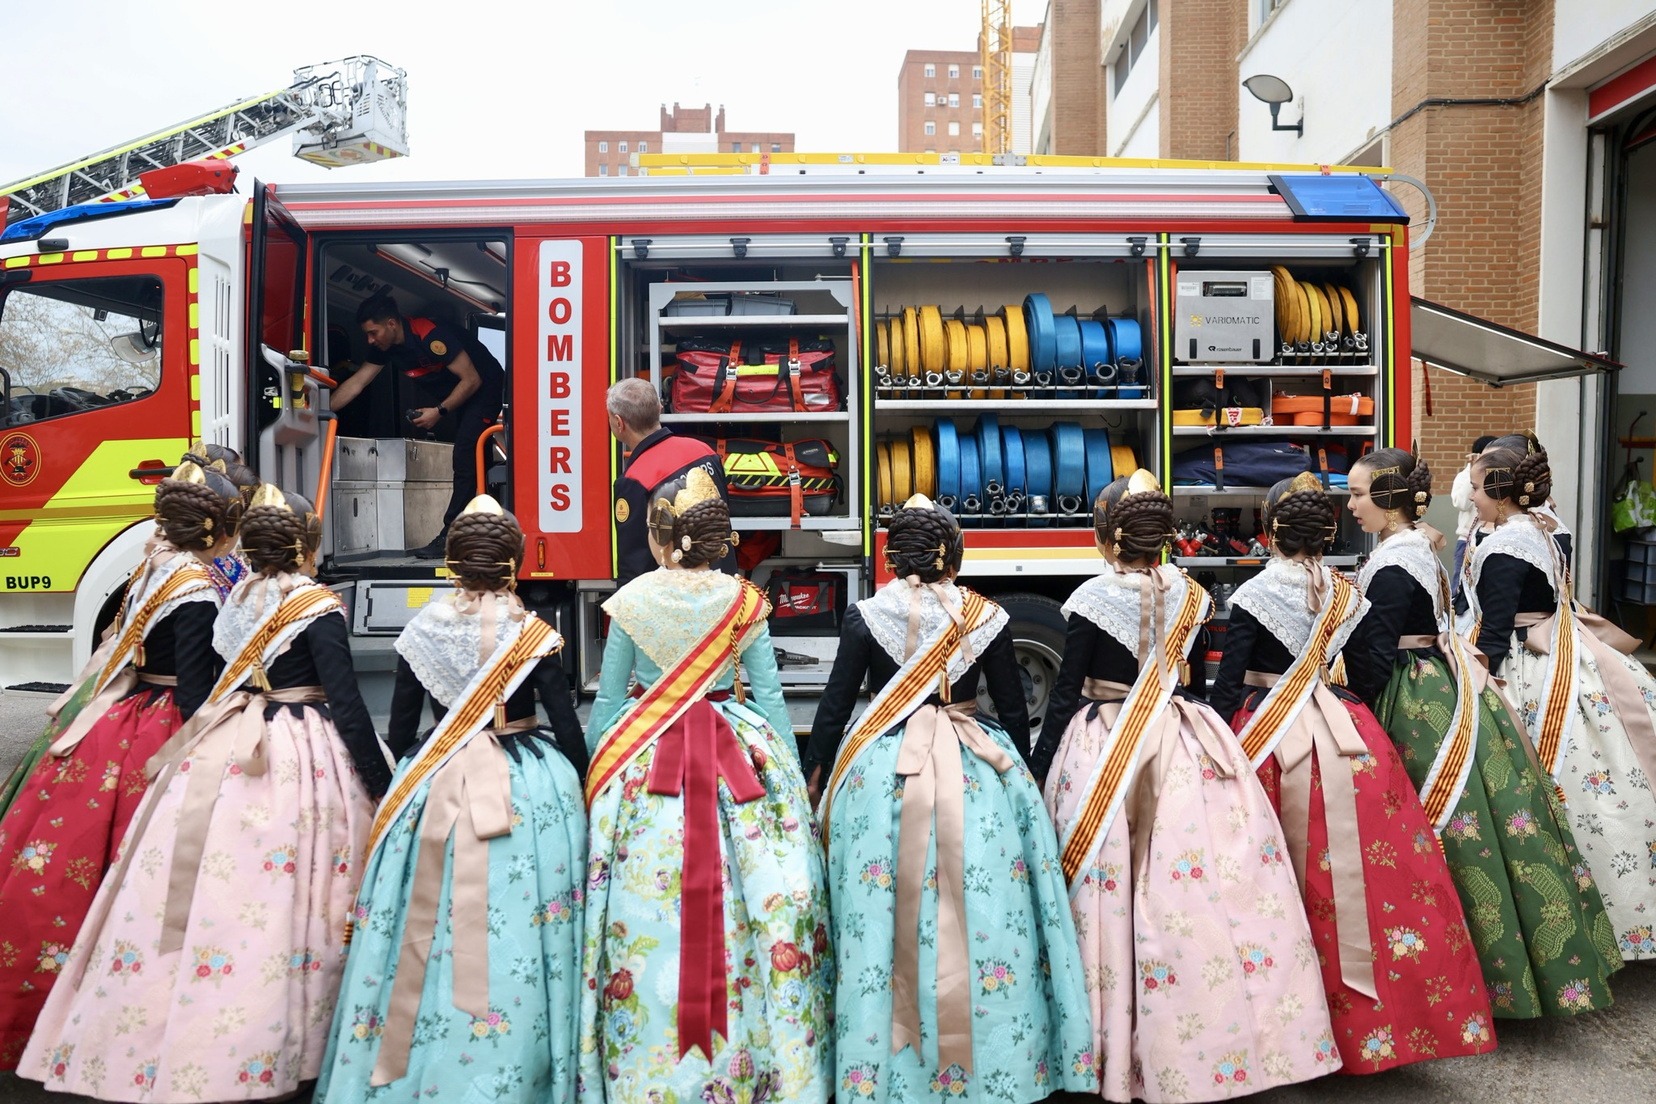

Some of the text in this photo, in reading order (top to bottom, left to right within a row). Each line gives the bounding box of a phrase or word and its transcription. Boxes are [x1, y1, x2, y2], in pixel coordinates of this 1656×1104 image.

[1205, 316, 1260, 325] VARIOMATIC
[547, 261, 573, 511] BOMBERS
[6, 576, 51, 589] BUP9
[778, 592, 810, 604] Miwaukee
